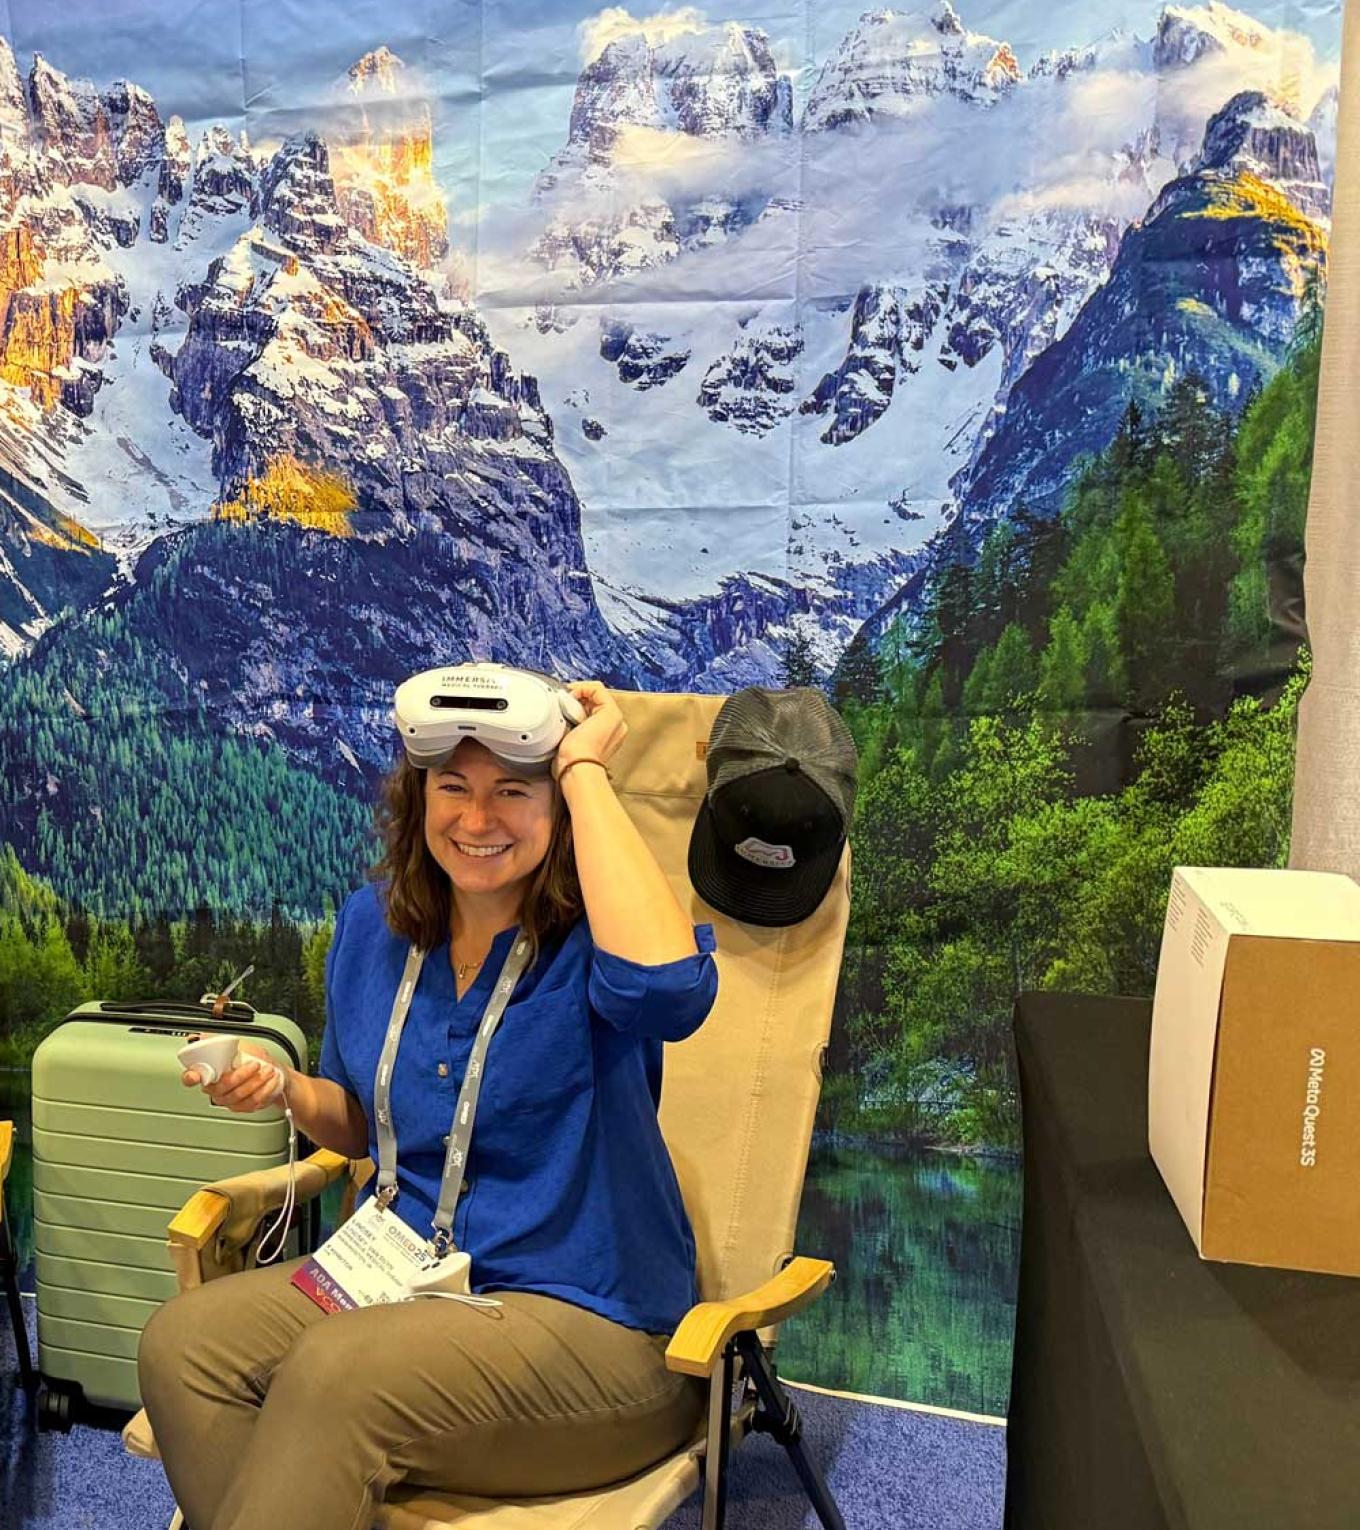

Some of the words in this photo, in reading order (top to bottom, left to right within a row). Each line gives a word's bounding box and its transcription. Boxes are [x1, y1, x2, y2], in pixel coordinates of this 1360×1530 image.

[1306, 1067, 1324, 1105] Meta
[1302, 1104, 1320, 1148] Quest
[1300, 1148, 1316, 1167] 3S
